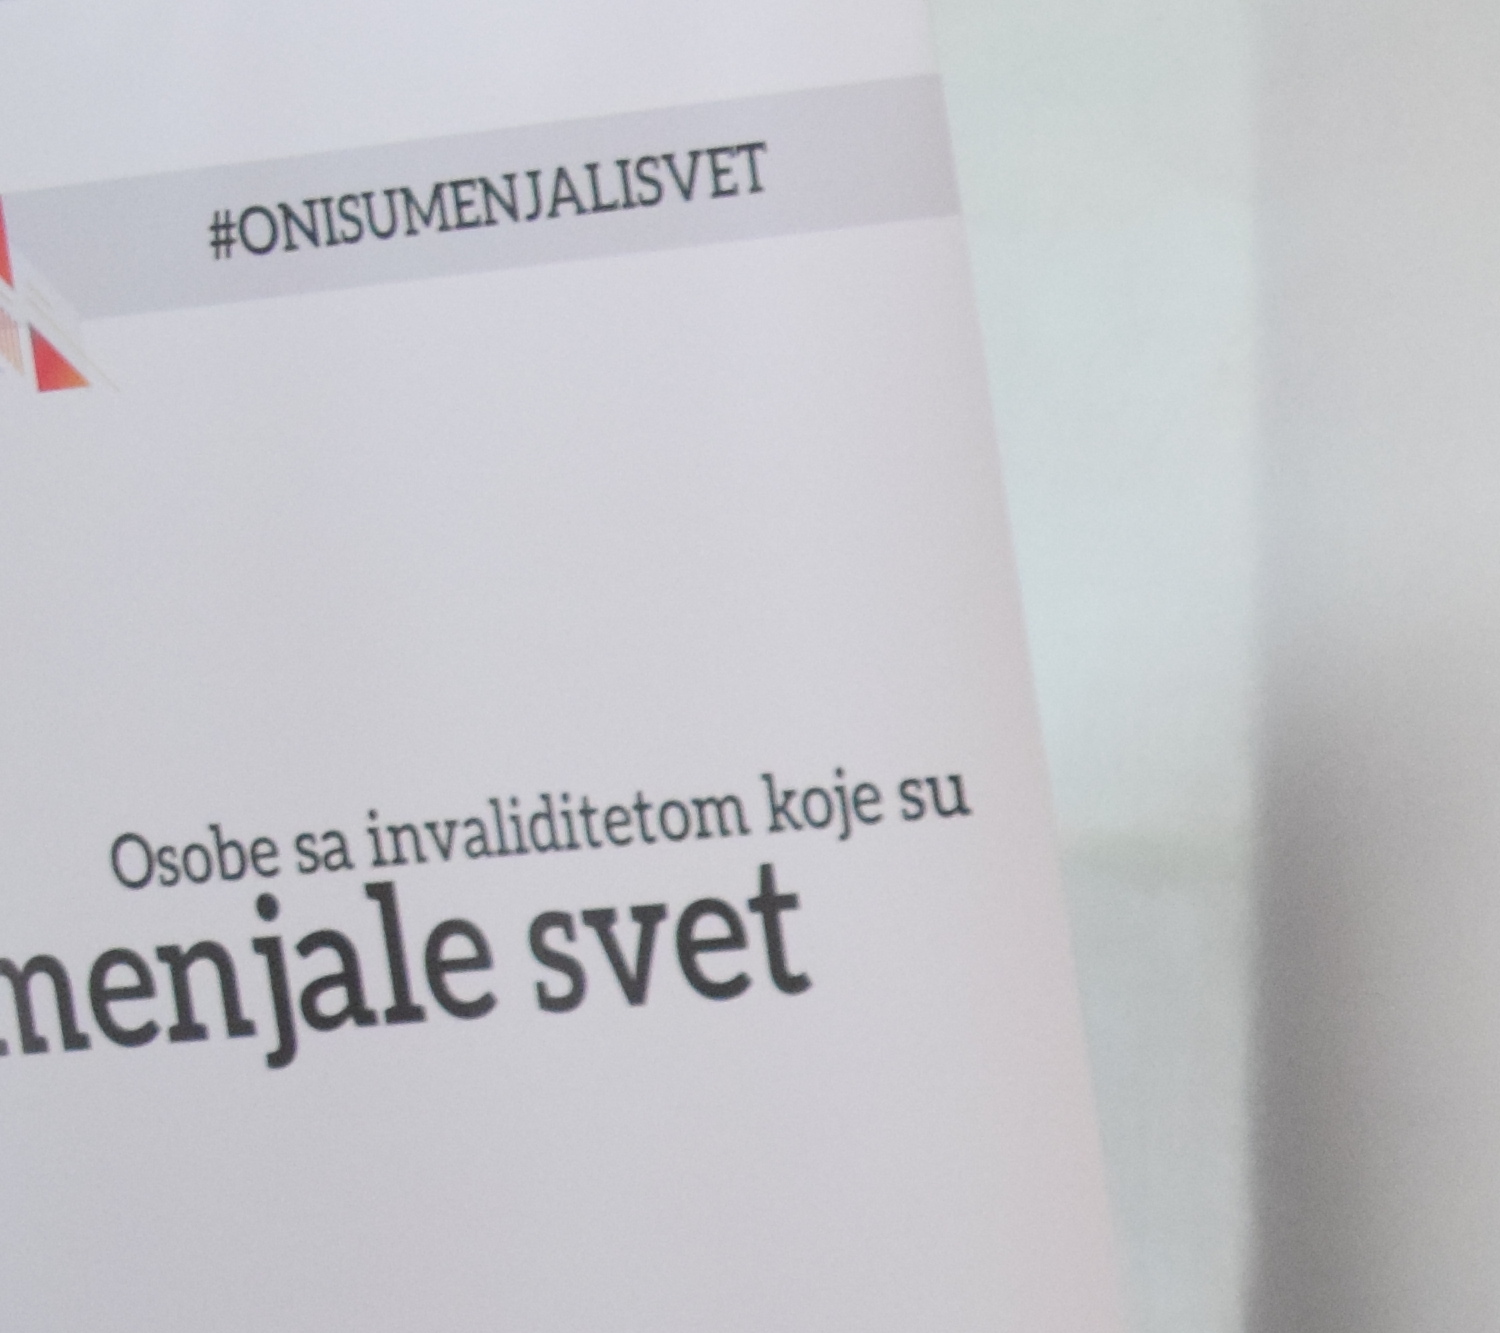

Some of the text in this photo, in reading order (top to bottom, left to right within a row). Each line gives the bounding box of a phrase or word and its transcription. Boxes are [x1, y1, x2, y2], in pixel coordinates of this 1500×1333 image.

[208, 141, 769, 261] #ONISUMENJALISVET
[110, 767, 972, 890] Osobe sa invaliditetom koje su
[0, 862, 813, 1070] menjale svet
